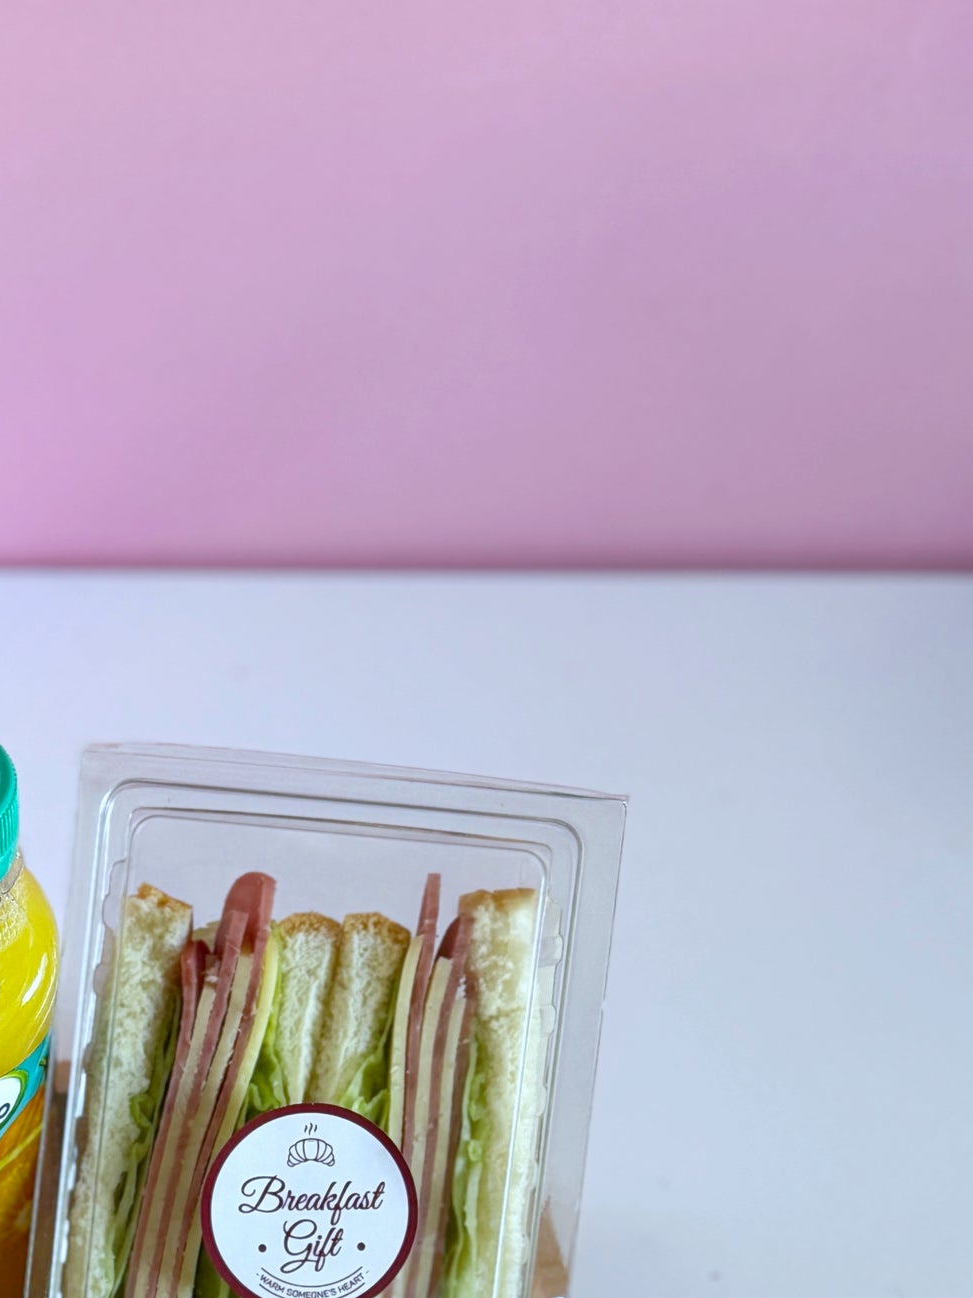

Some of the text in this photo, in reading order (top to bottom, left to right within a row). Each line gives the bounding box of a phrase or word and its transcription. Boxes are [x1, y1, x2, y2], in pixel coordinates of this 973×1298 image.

[238, 1174, 386, 1226] Breakfast
[280, 1218, 344, 1275] Gift
[259, 1273, 286, 1294] WARM
[337, 1272, 366, 1294] HEART
